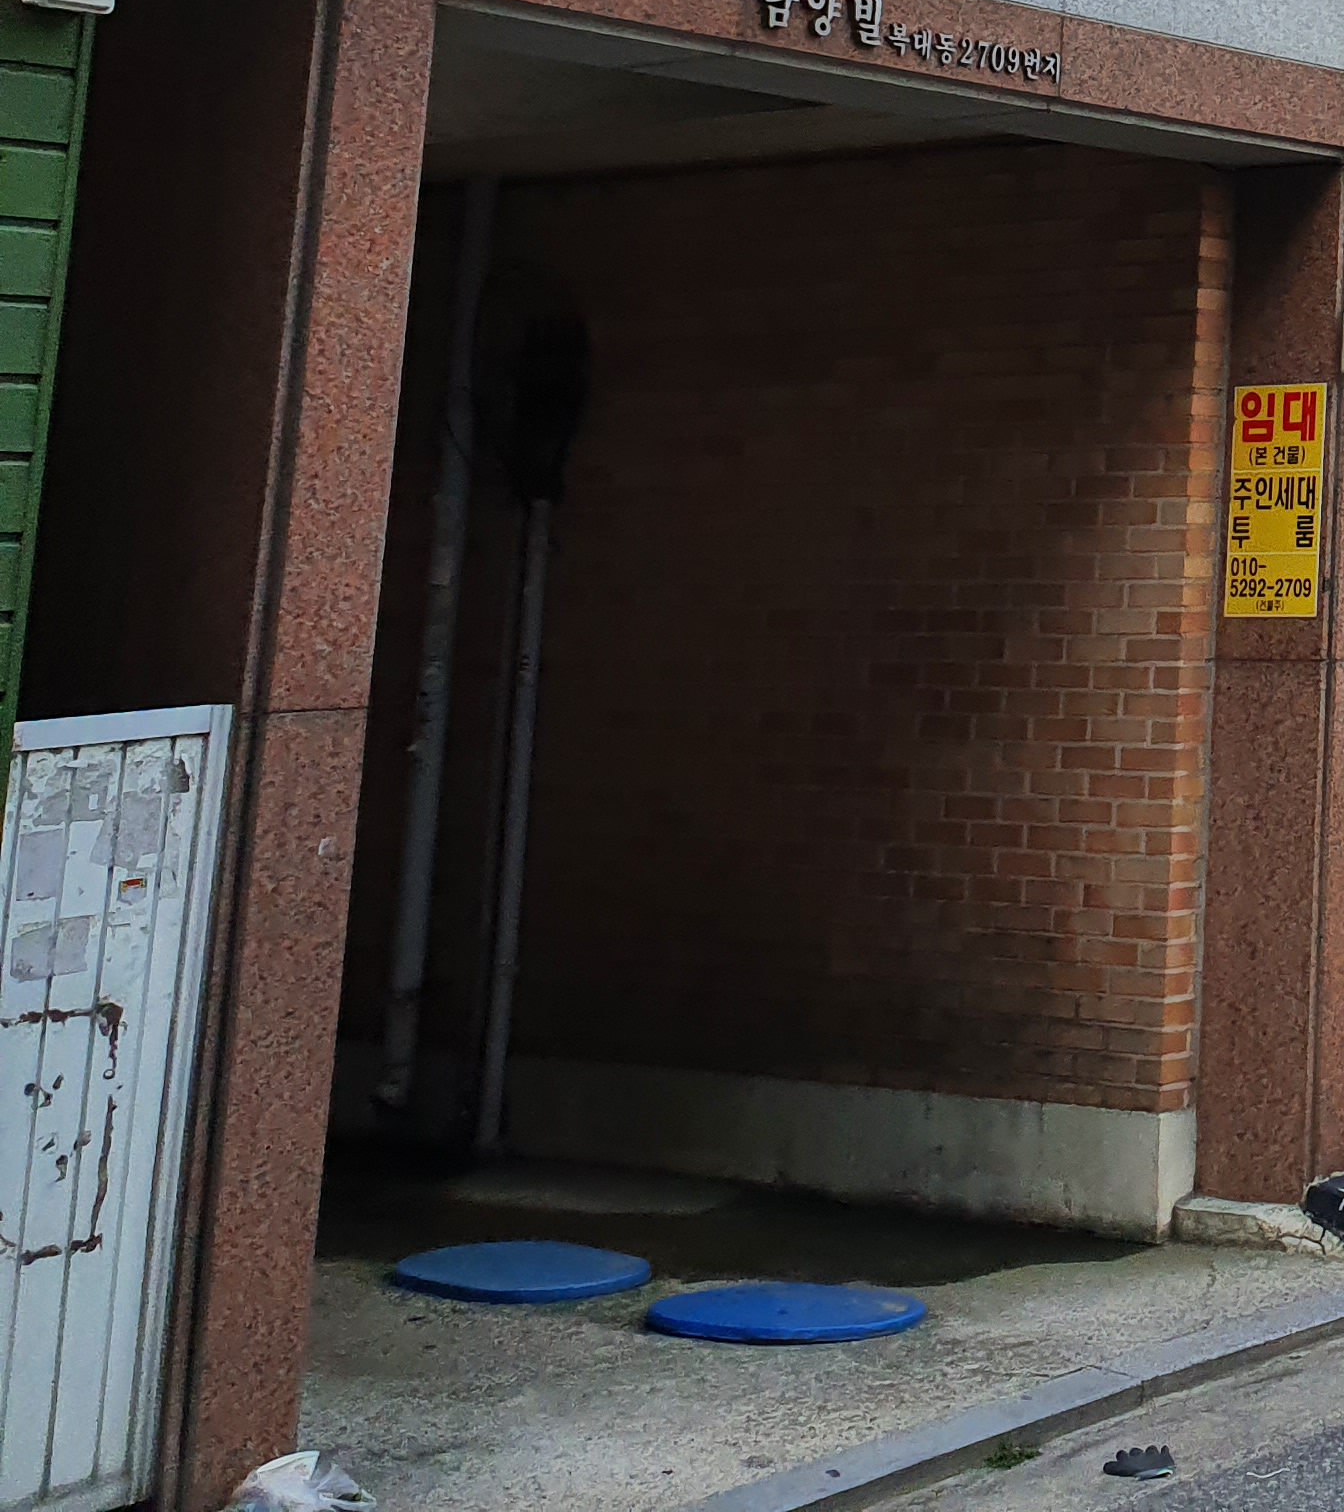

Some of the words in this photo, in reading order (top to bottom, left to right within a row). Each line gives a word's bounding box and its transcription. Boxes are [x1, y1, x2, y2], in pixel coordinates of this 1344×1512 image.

[1240, 391, 1318, 443] 임대
[1273, 447, 1307, 465] 건물)
[1232, 475, 1316, 511] 주인세대
[1230, 557, 1266, 578] 010-
[1229, 578, 1312, 598] 5292-2709
